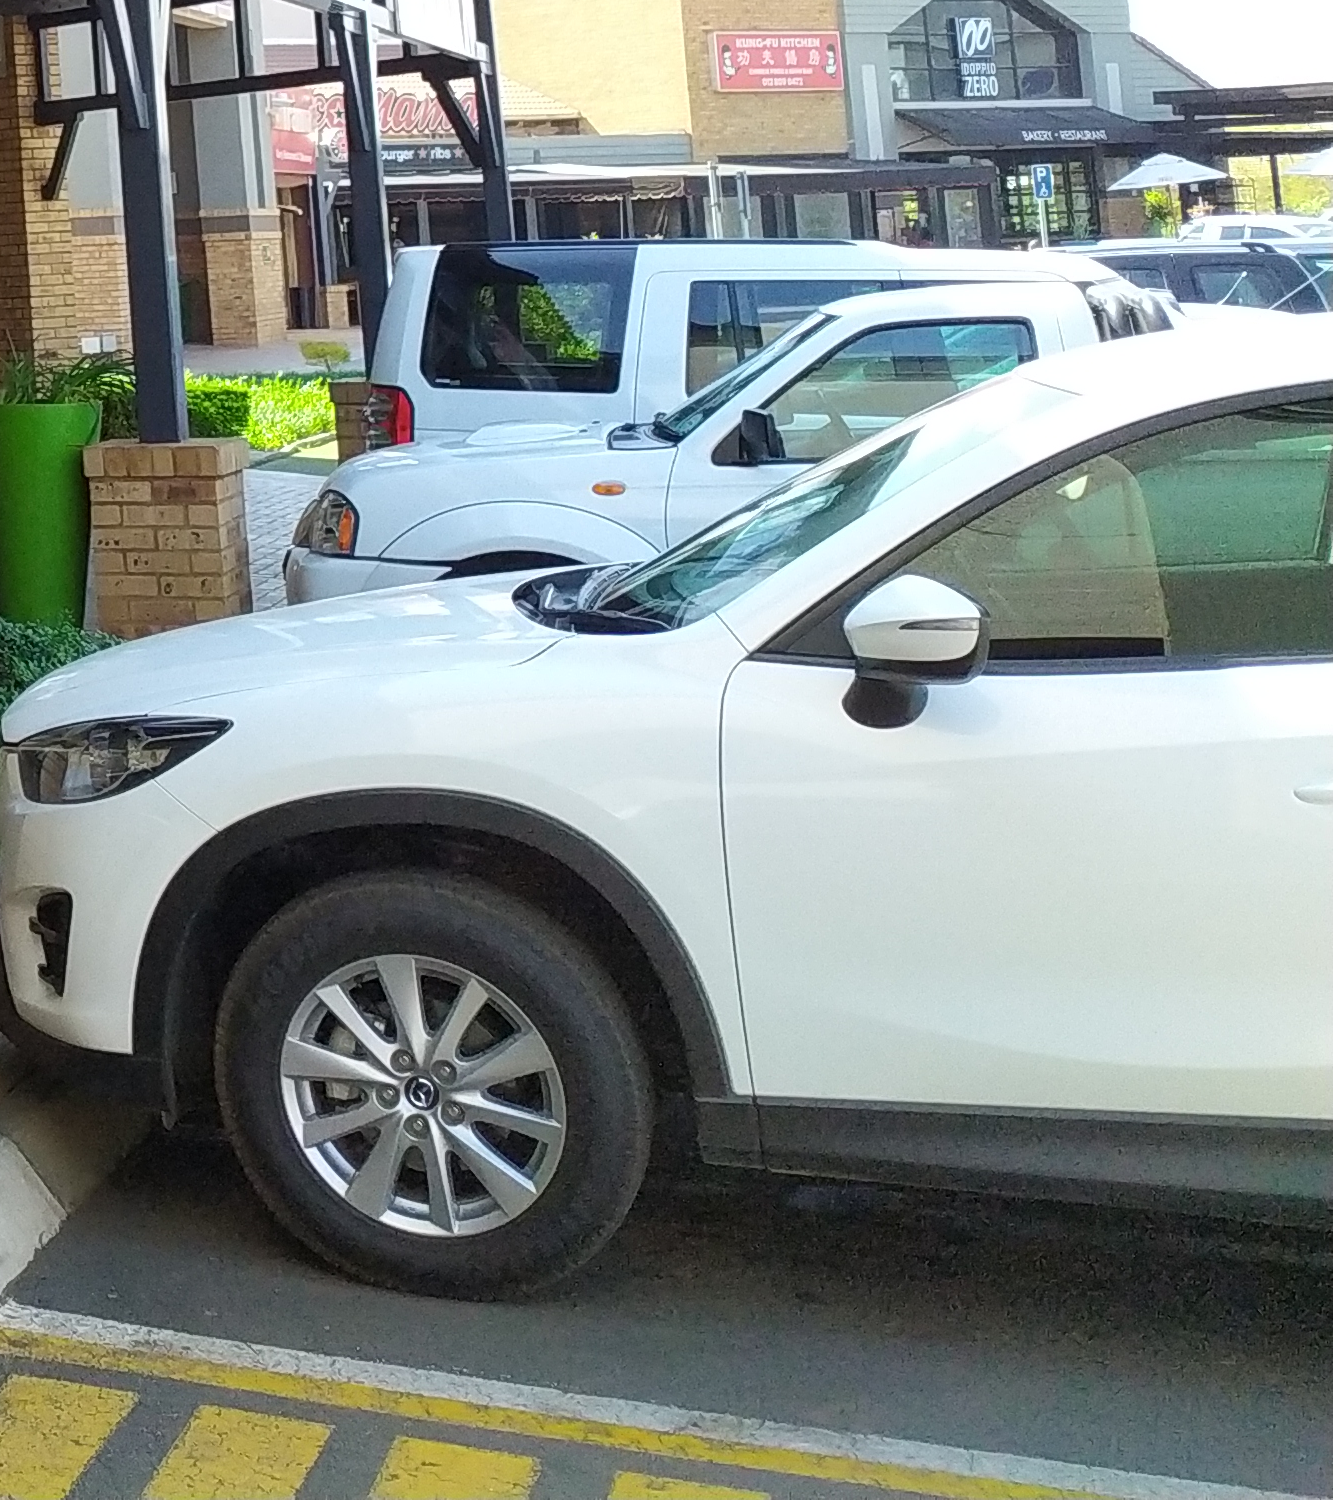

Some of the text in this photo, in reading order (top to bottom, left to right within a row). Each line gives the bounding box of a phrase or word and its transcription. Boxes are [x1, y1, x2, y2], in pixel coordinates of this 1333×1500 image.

[780, 37, 820, 48] KITCHEN
[961, 62, 996, 76] DOPPIO
[962, 75, 999, 97] ZERO
[1021, 129, 1108, 142] BAKERY RESTAURANT
[430, 146, 452, 160] ribs
[1036, 167, 1047, 182] P
